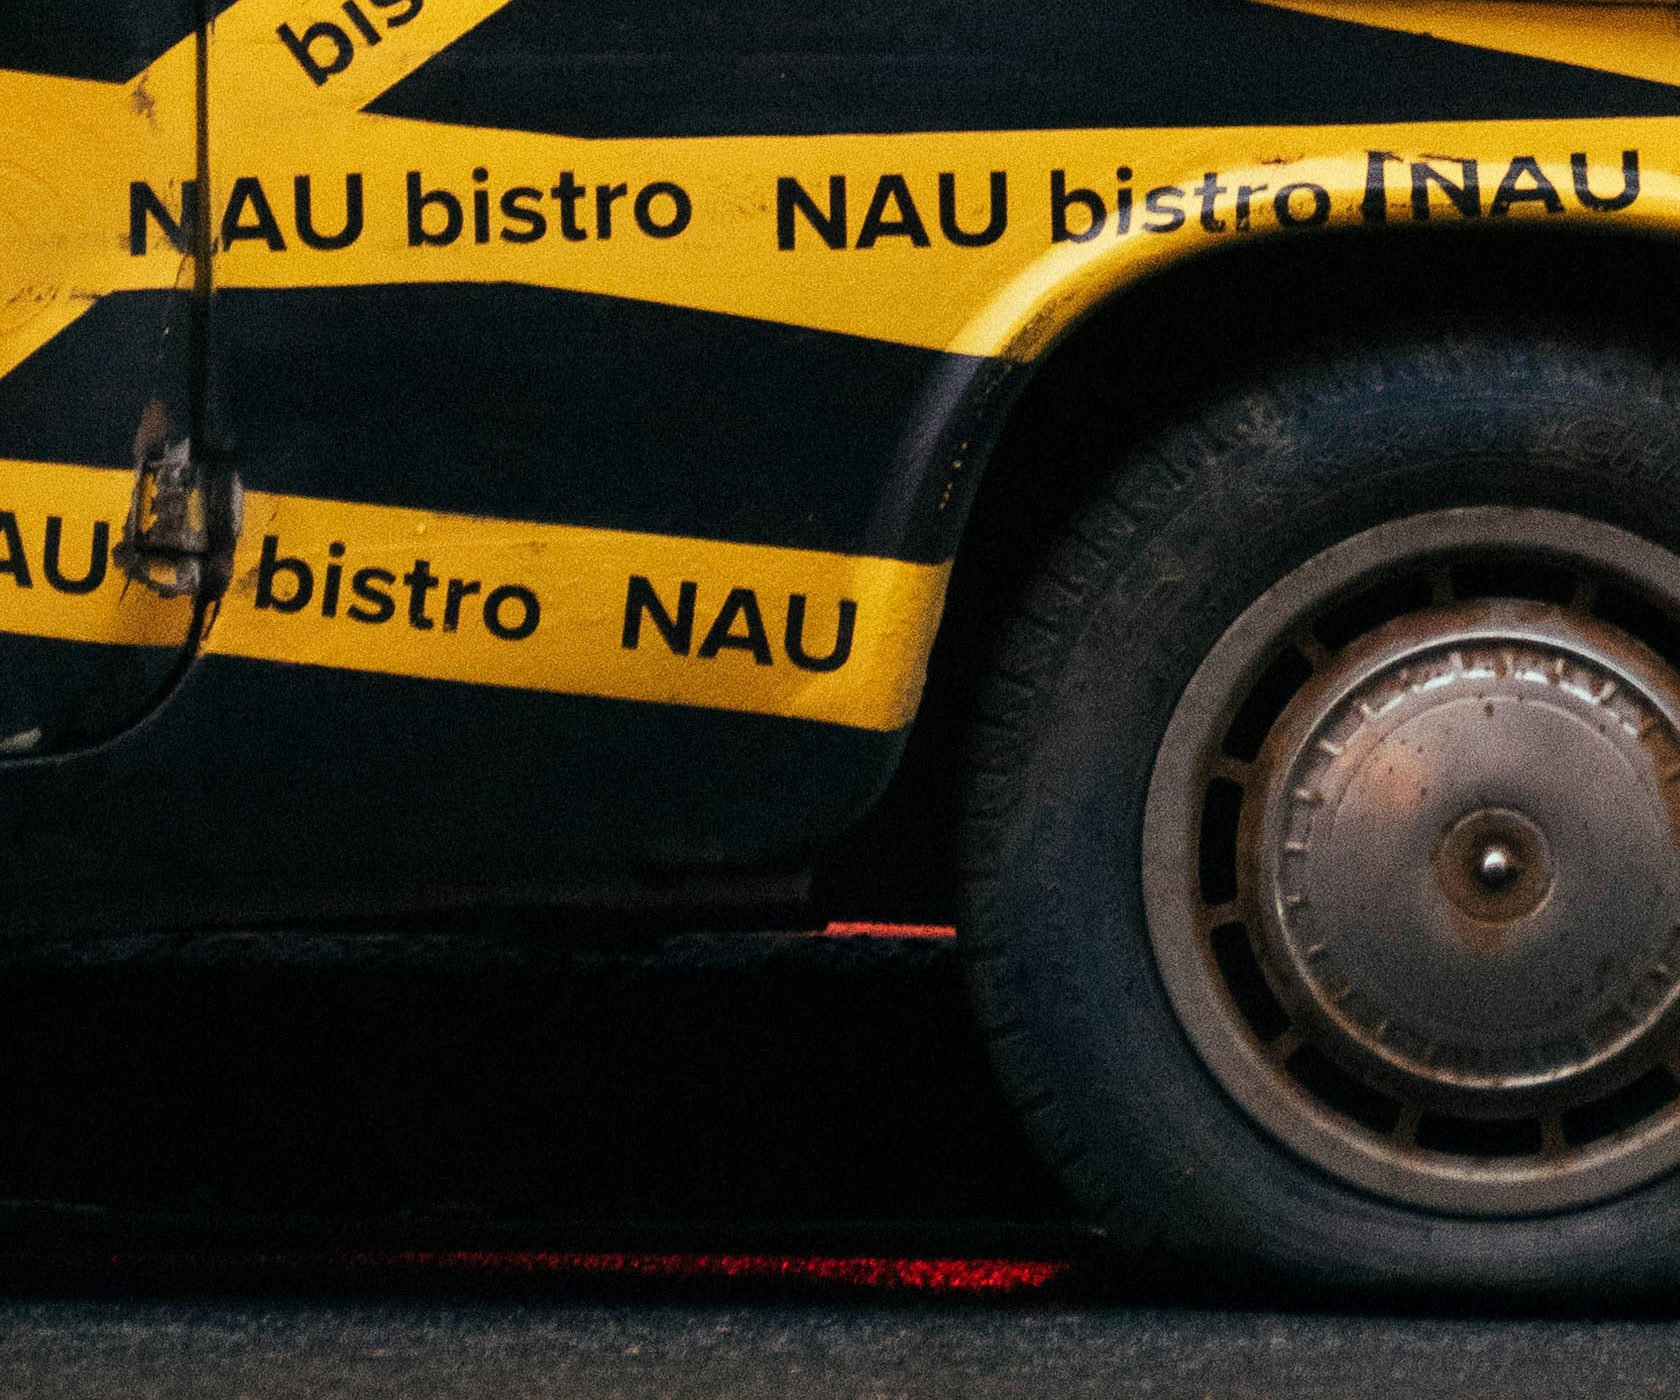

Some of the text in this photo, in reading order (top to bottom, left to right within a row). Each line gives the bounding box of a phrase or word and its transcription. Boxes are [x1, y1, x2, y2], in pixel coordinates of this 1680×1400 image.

[128, 172, 364, 257] NAU
[405, 167, 693, 248] bistro
[776, 171, 1008, 252] NAU
[1050, 166, 1332, 245] bistro
[252, 533, 543, 642] bistro
[621, 574, 858, 674] NAU
